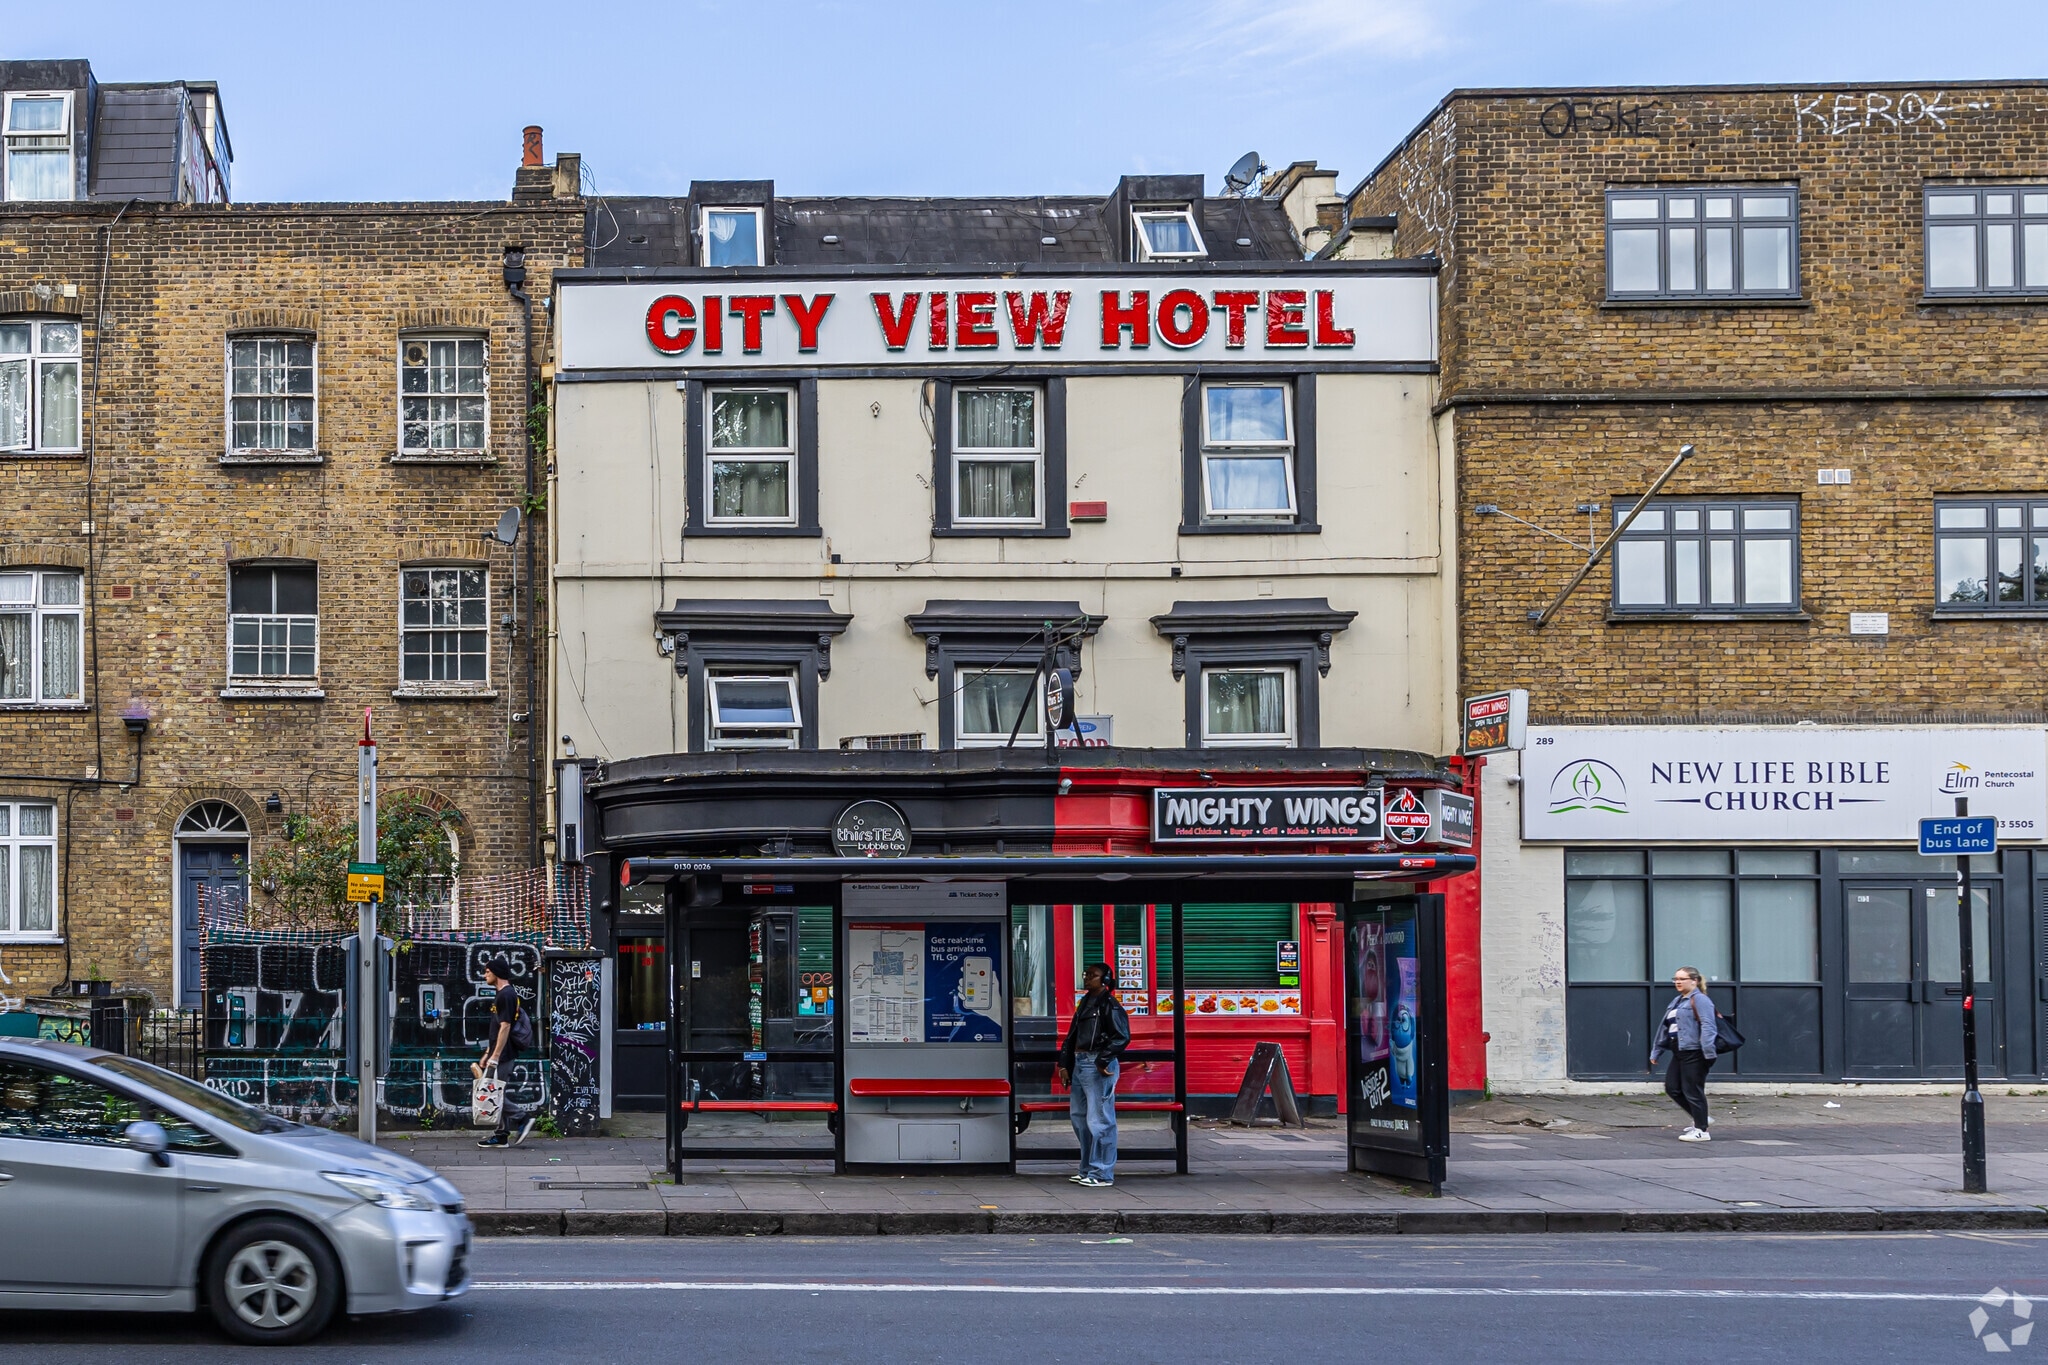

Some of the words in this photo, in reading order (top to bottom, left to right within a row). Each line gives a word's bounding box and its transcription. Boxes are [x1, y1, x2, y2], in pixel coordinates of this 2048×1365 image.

[645, 292, 836, 355] CITY
[869, 289, 1070, 351] VIEW
[1099, 288, 1357, 350] HOTEL
[1471, 703, 1490, 717] MIGHTY
[1490, 700, 1507, 713] WINGS
[1475, 719, 1485, 727] OPEN
[1493, 716, 1502, 724] LATE
[1535, 737, 1554, 746] 289
[1651, 761, 1724, 785] NEW
[1733, 761, 1796, 785] LIFE
[1806, 761, 1890, 784] BIBLE
[1945, 772, 1979, 788] Elim
[1704, 791, 1835, 811] CHURCH
[1165, 797, 1273, 825] MIGHTY
[1283, 796, 1377, 825] WINGS
[1387, 815, 1408, 824] MIGHTY
[1410, 816, 1428, 825] WINGS
[2009, 820, 2034, 828] 5505
[1175, 827, 1193, 836] Fried
[1194, 827, 1222, 835] Chicken
[1229, 828, 1253, 837] Burger
[1262, 827, 1278, 835] Grill
[1316, 827, 1331, 835] Fish
[1338, 827, 1358, 837] Chips
[1933, 824, 1961, 835] End
[1967, 823, 1983, 834] of
[837, 828, 905, 842] thirsTEA
[858, 842, 888, 850] bubble
[890, 842, 905, 850] tea
[1926, 838, 1952, 848] bus
[1957, 837, 1989, 848] lane
[931, 936, 946, 944] Get
[948, 936, 984, 944] real-time
[930, 945, 946, 953] bus
[947, 945, 975, 953] arrivals
[931, 953, 945, 961] TfL
[946, 953, 958, 961] Go
[1361, 1072, 1381, 1100] INSIDE
[1370, 1087, 1382, 1109] OUT
[1379, 1067, 1391, 1100] 2
